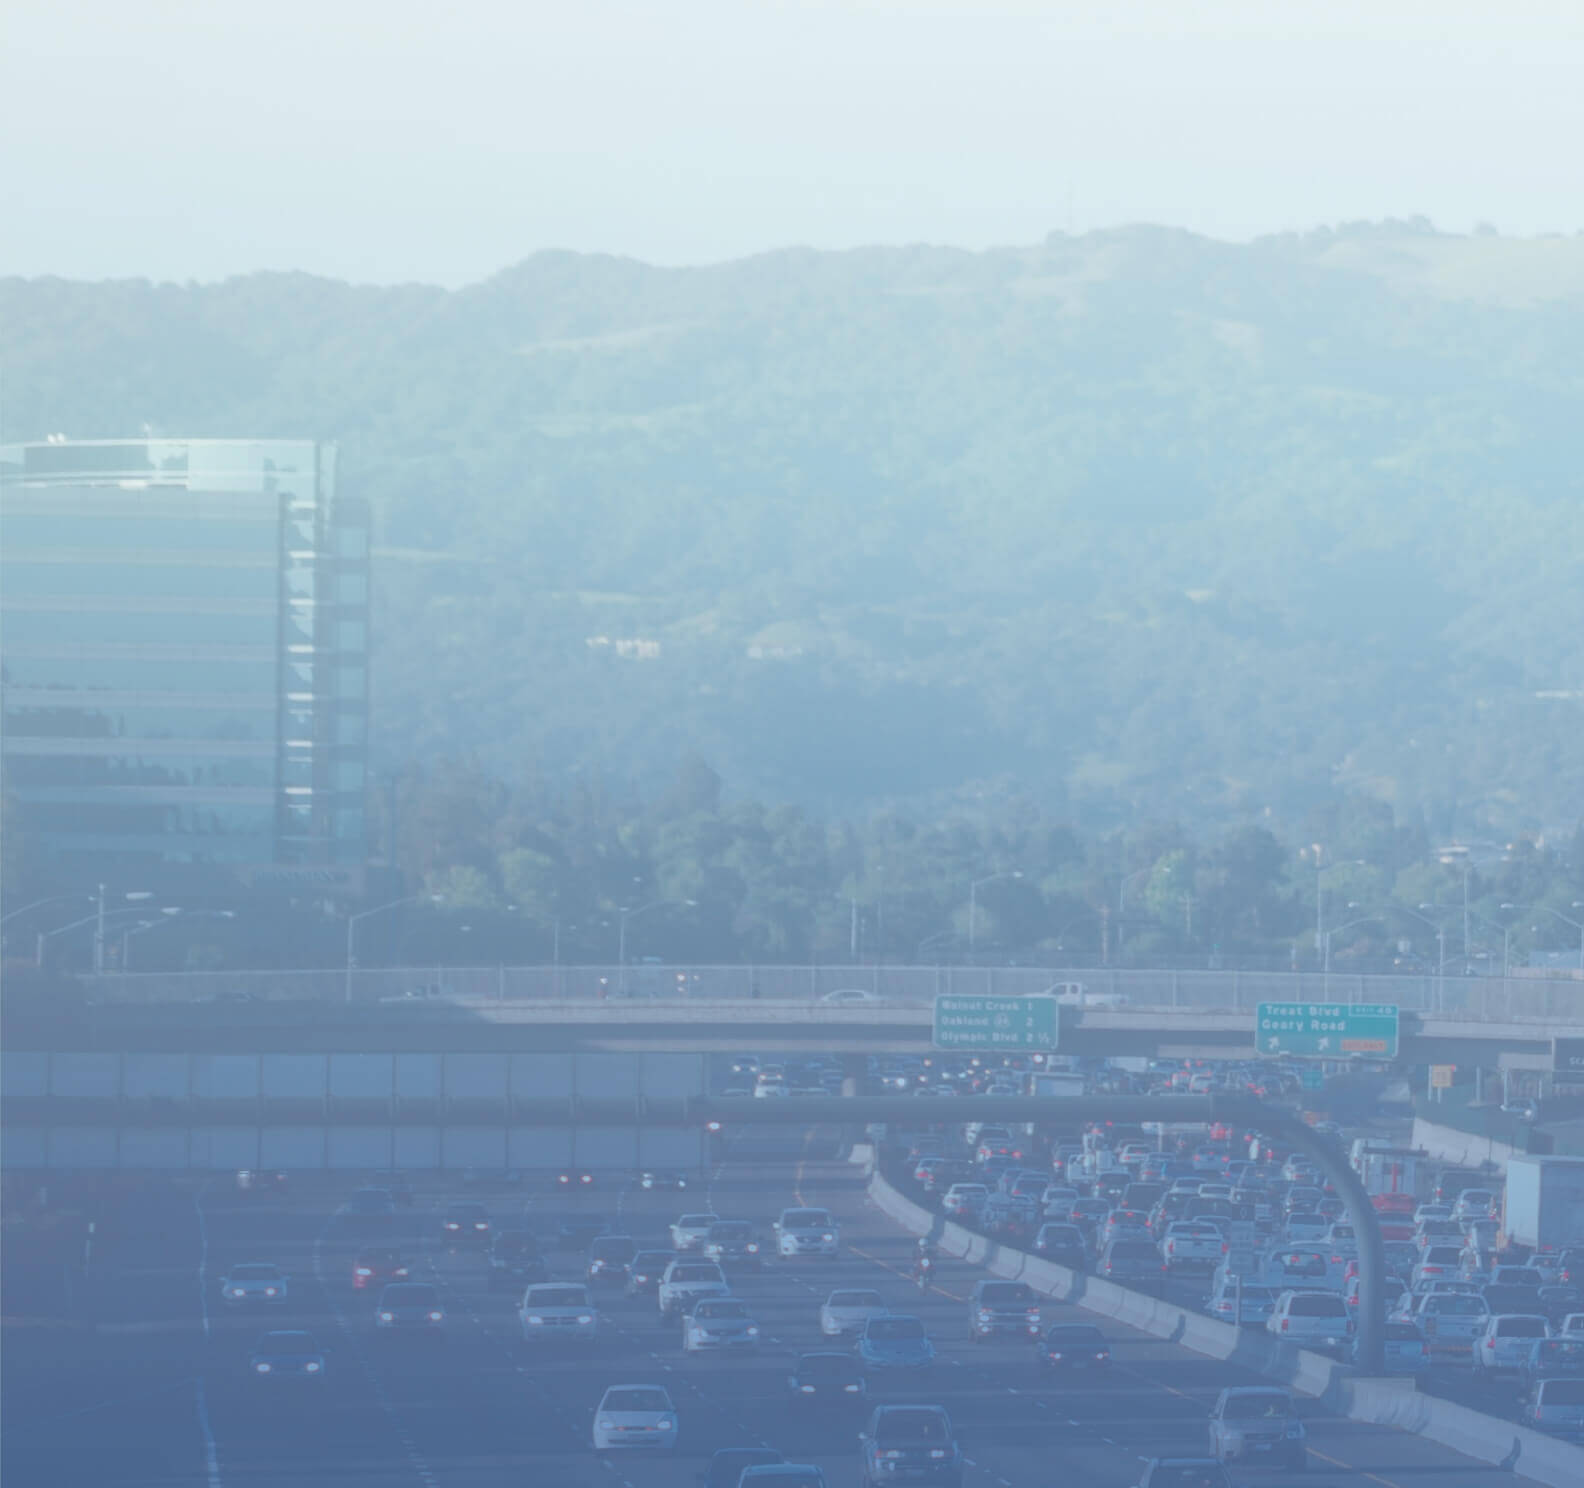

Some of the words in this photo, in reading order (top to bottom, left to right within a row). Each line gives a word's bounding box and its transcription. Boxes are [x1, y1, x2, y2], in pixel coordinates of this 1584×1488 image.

[985, 1000, 1019, 1011] Creek
[1265, 1005, 1303, 1016] Treat
[1309, 1005, 1340, 1017] Blvd
[941, 1015, 989, 1025] Oakland
[1261, 1018, 1304, 1031] Geary
[1311, 1018, 1346, 1032] Road
[941, 1032, 987, 1043] Olympic
[992, 1032, 1019, 1042] Blvd
